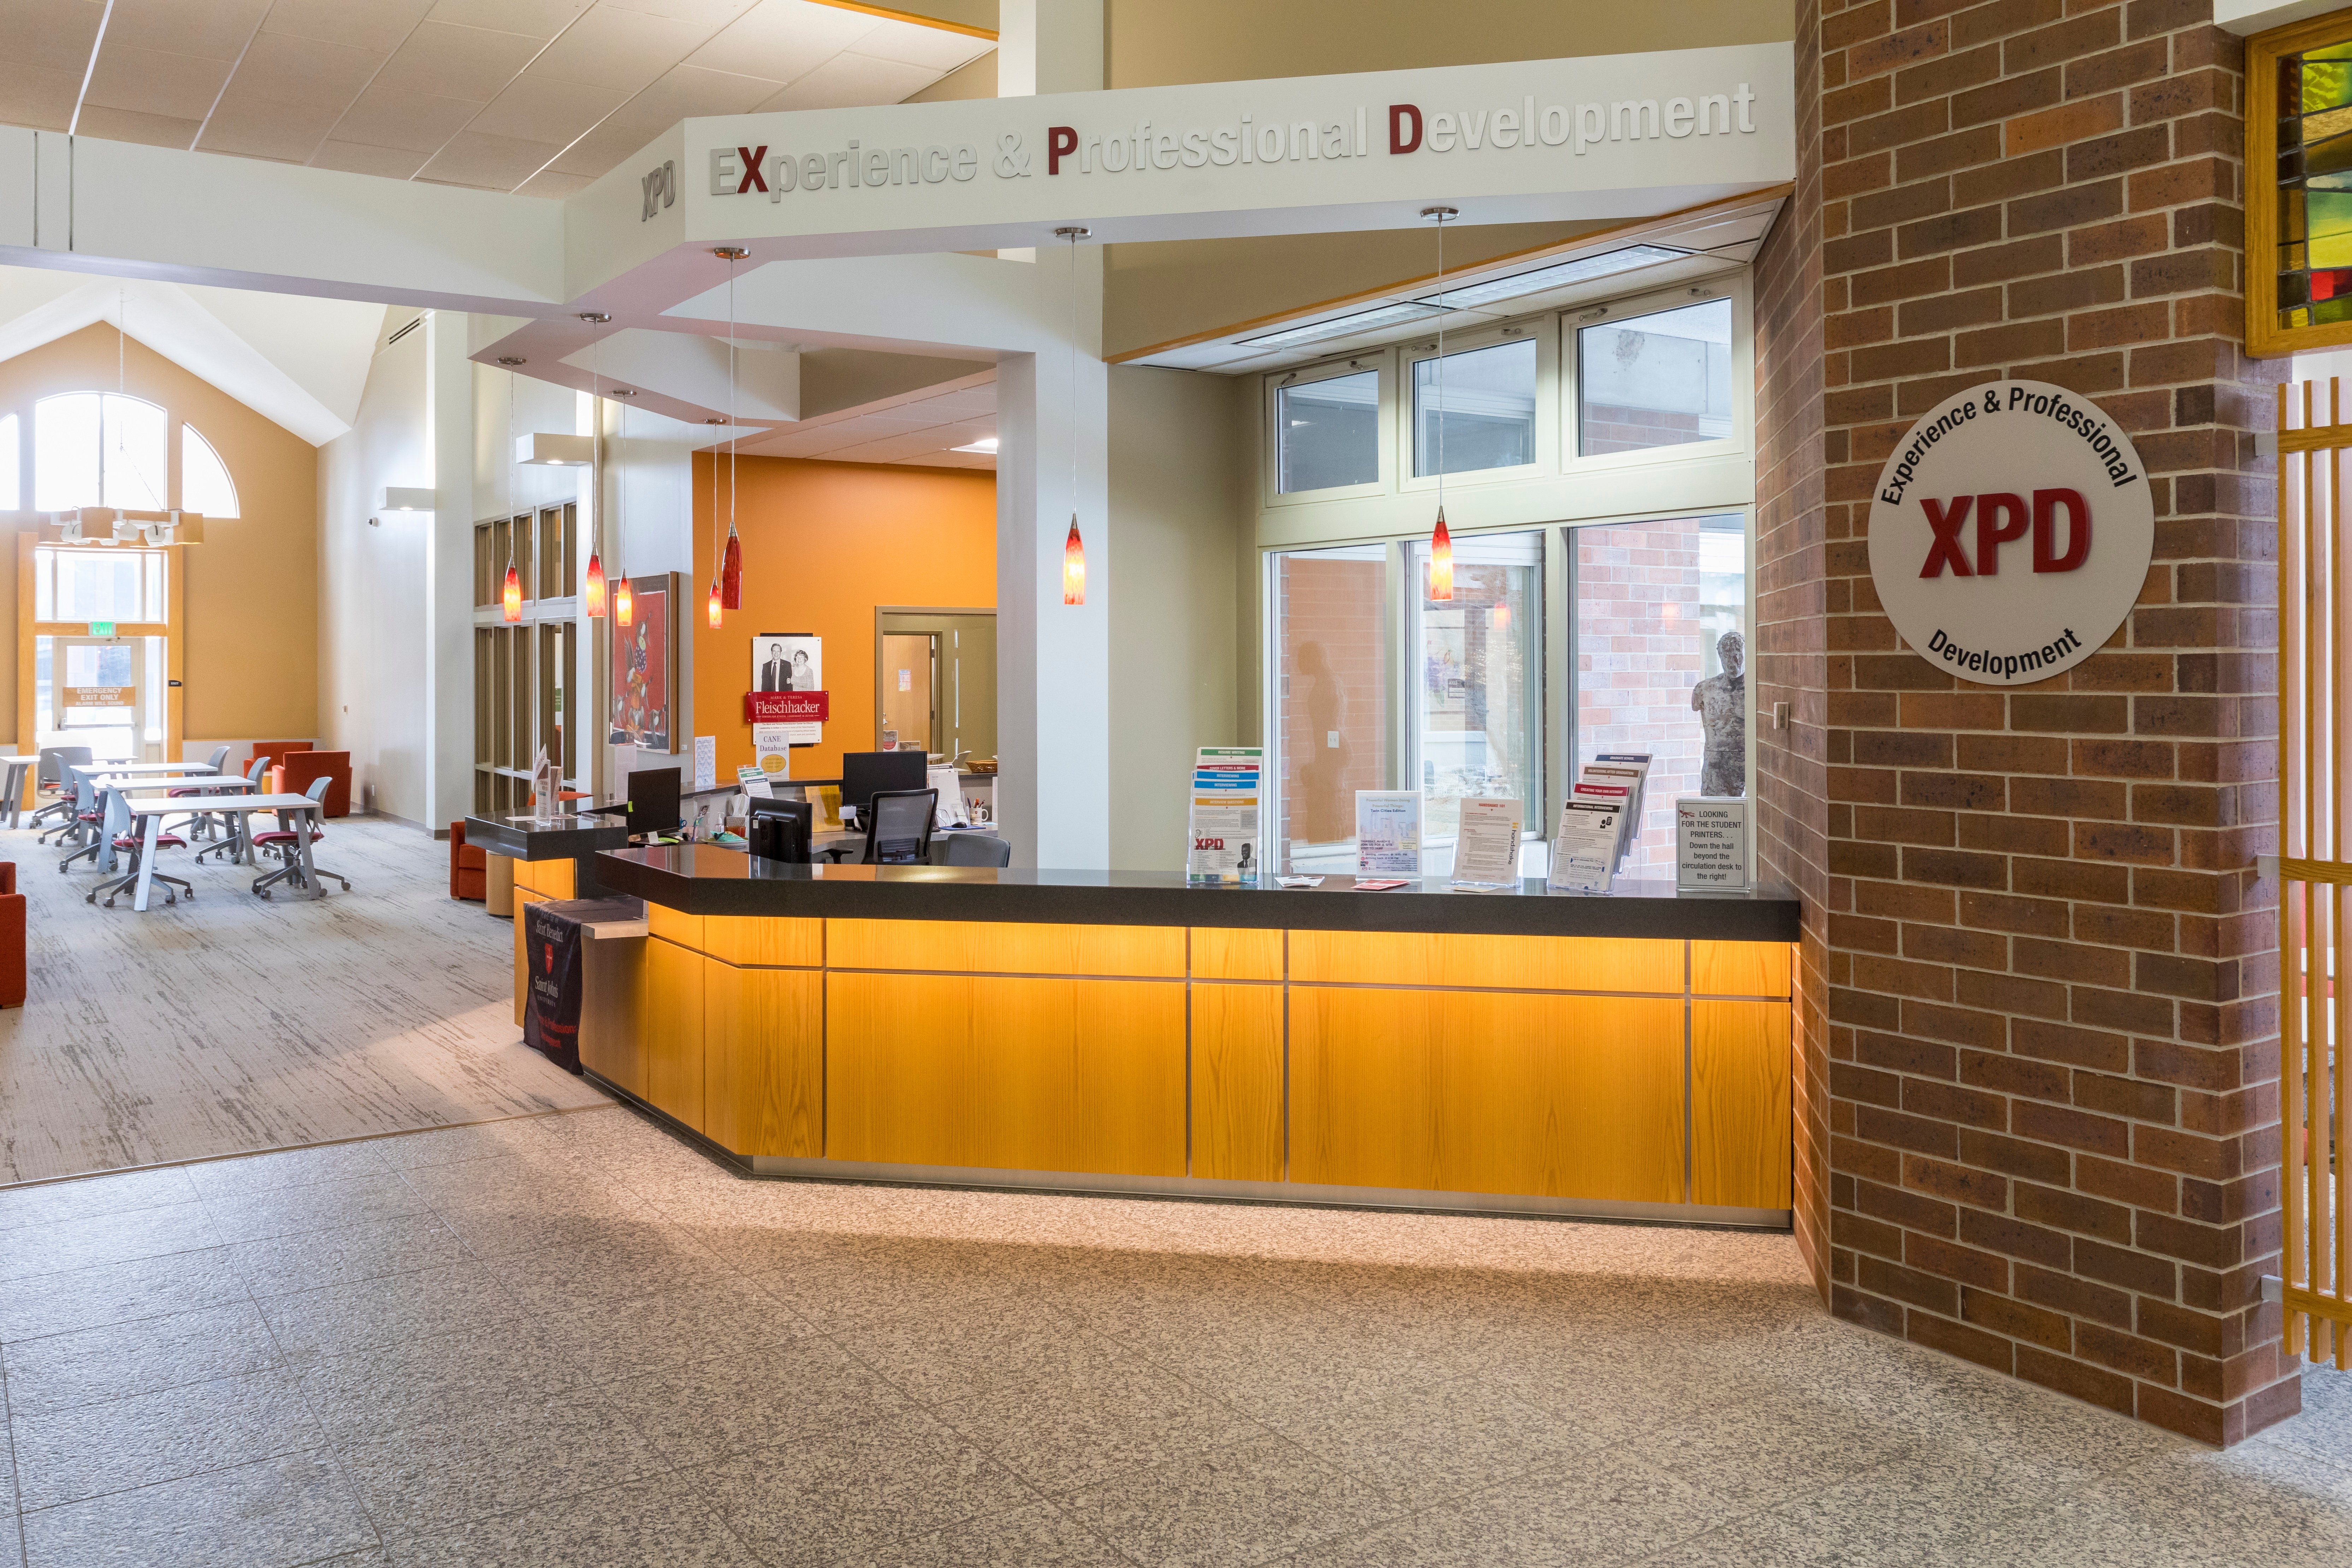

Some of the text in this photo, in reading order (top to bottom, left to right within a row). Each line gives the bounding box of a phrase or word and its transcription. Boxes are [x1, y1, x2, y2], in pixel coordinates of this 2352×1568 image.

[710, 82, 1756, 203] EXperience & Professional Development
[641, 160, 676, 222] XPD
[1880, 386, 2138, 506] Experience & Professional
[1918, 487, 2092, 579] XPD
[93, 622, 113, 635] EXIT
[1927, 627, 2082, 680] Development
[756, 700, 820, 714] Fleischhacker
[1195, 838, 1224, 850] XPD
[1508, 830, 1517, 865] handshake
[536, 920, 563, 942] Saint Benedict
[535, 976, 558, 998] Saint John's
[537, 995, 555, 1007] UNIVERSITY
